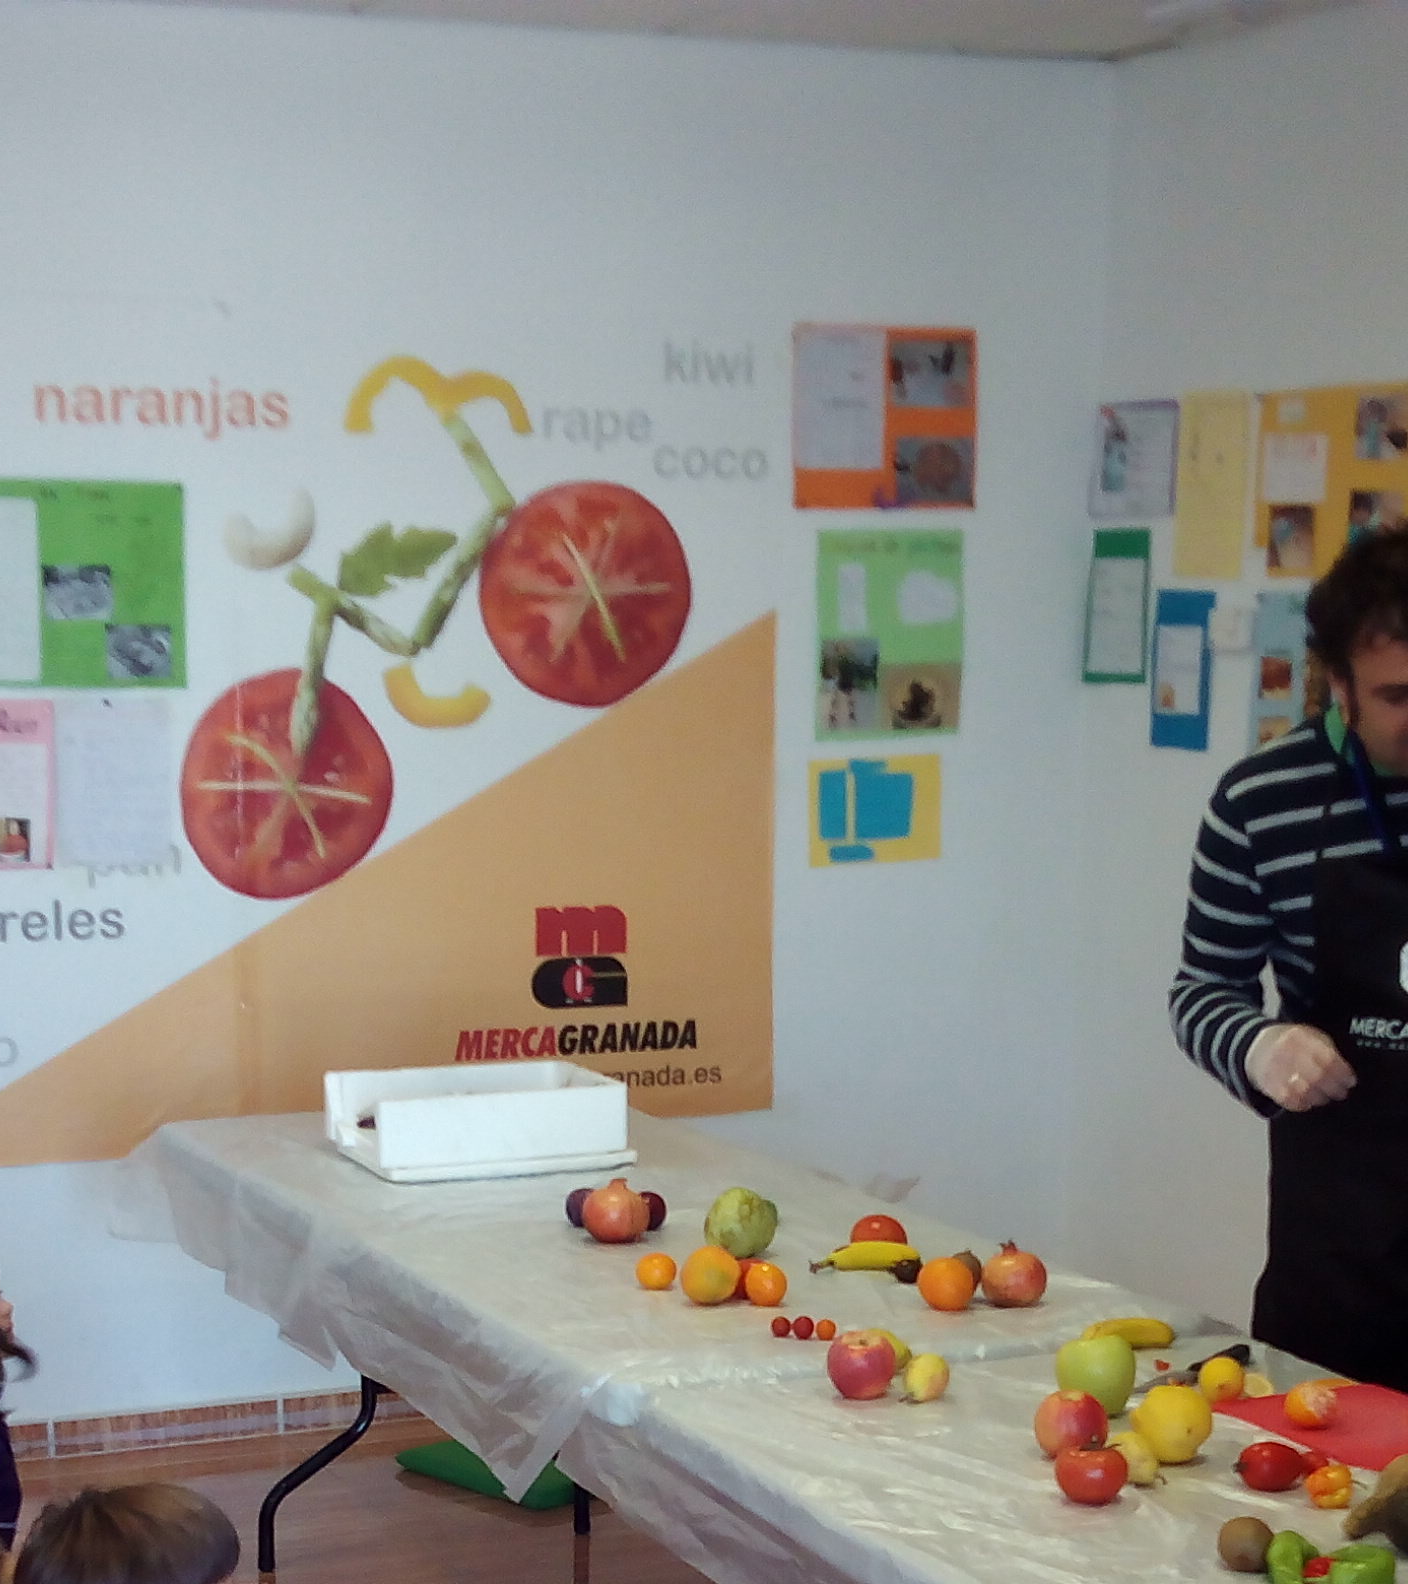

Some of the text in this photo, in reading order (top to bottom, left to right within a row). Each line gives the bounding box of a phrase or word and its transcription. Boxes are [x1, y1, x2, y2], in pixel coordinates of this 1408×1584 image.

[662, 341, 755, 385] kiwi
[33, 376, 290, 441] naranjas
[541, 403, 653, 451] rape
[652, 441, 770, 482] coco
[454, 1018, 697, 1063] MERCAGRANADA
[606, 1064, 723, 1091] anada.es
